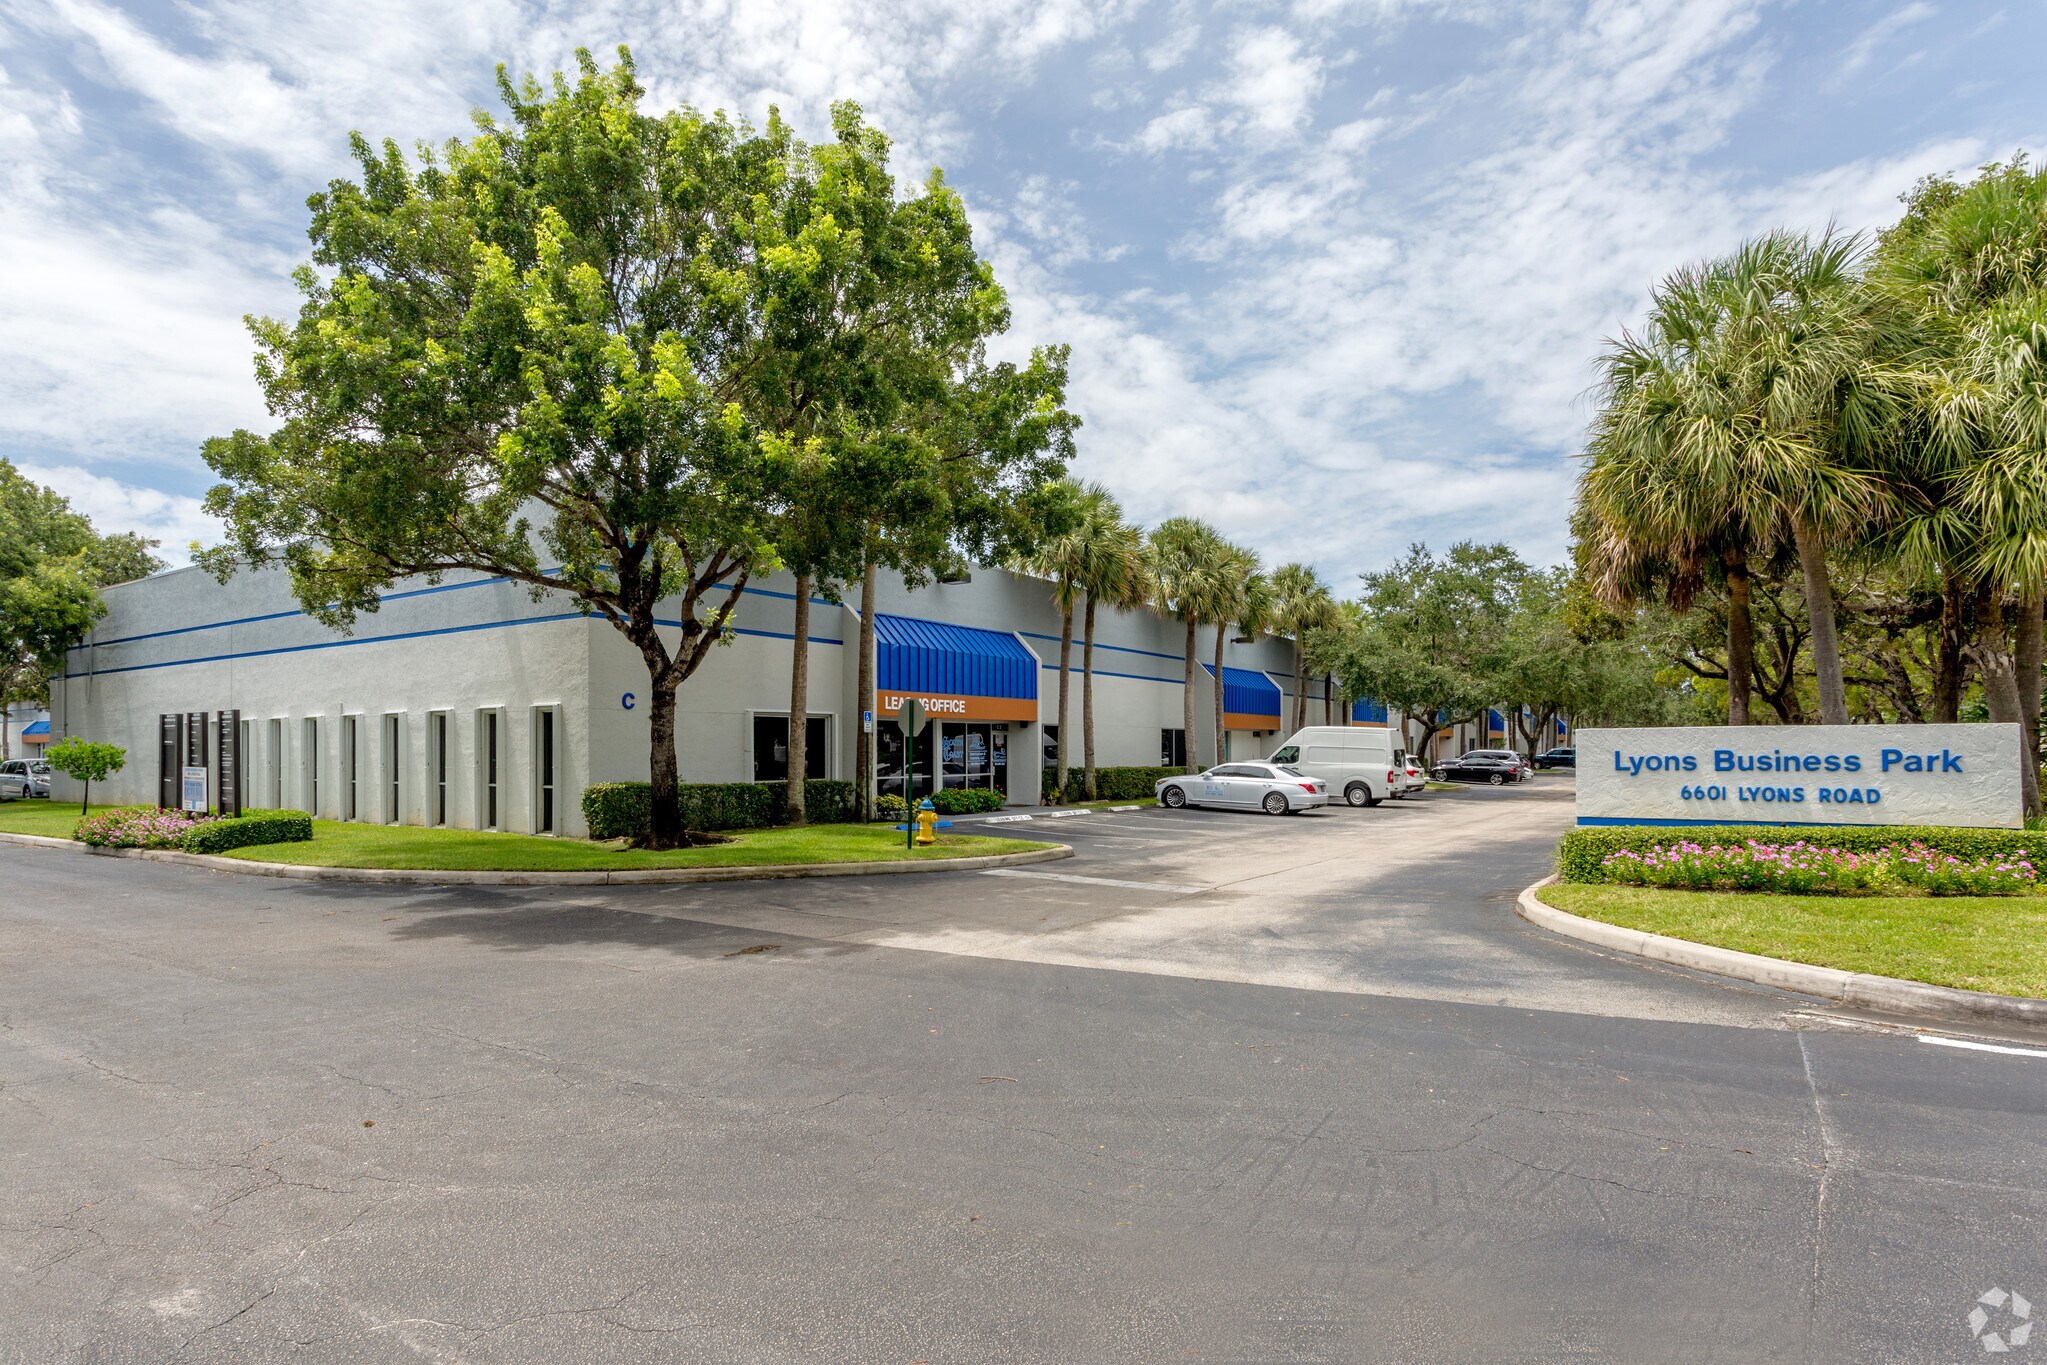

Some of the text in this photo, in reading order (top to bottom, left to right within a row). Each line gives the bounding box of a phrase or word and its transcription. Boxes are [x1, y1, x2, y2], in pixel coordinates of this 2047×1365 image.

[622, 692, 635, 710] C
[885, 696, 966, 713] LEAG OFFICE
[1615, 748, 1963, 776] Lyons Business Park
[1681, 785, 1881, 804] 6601 LYONS ROAD
